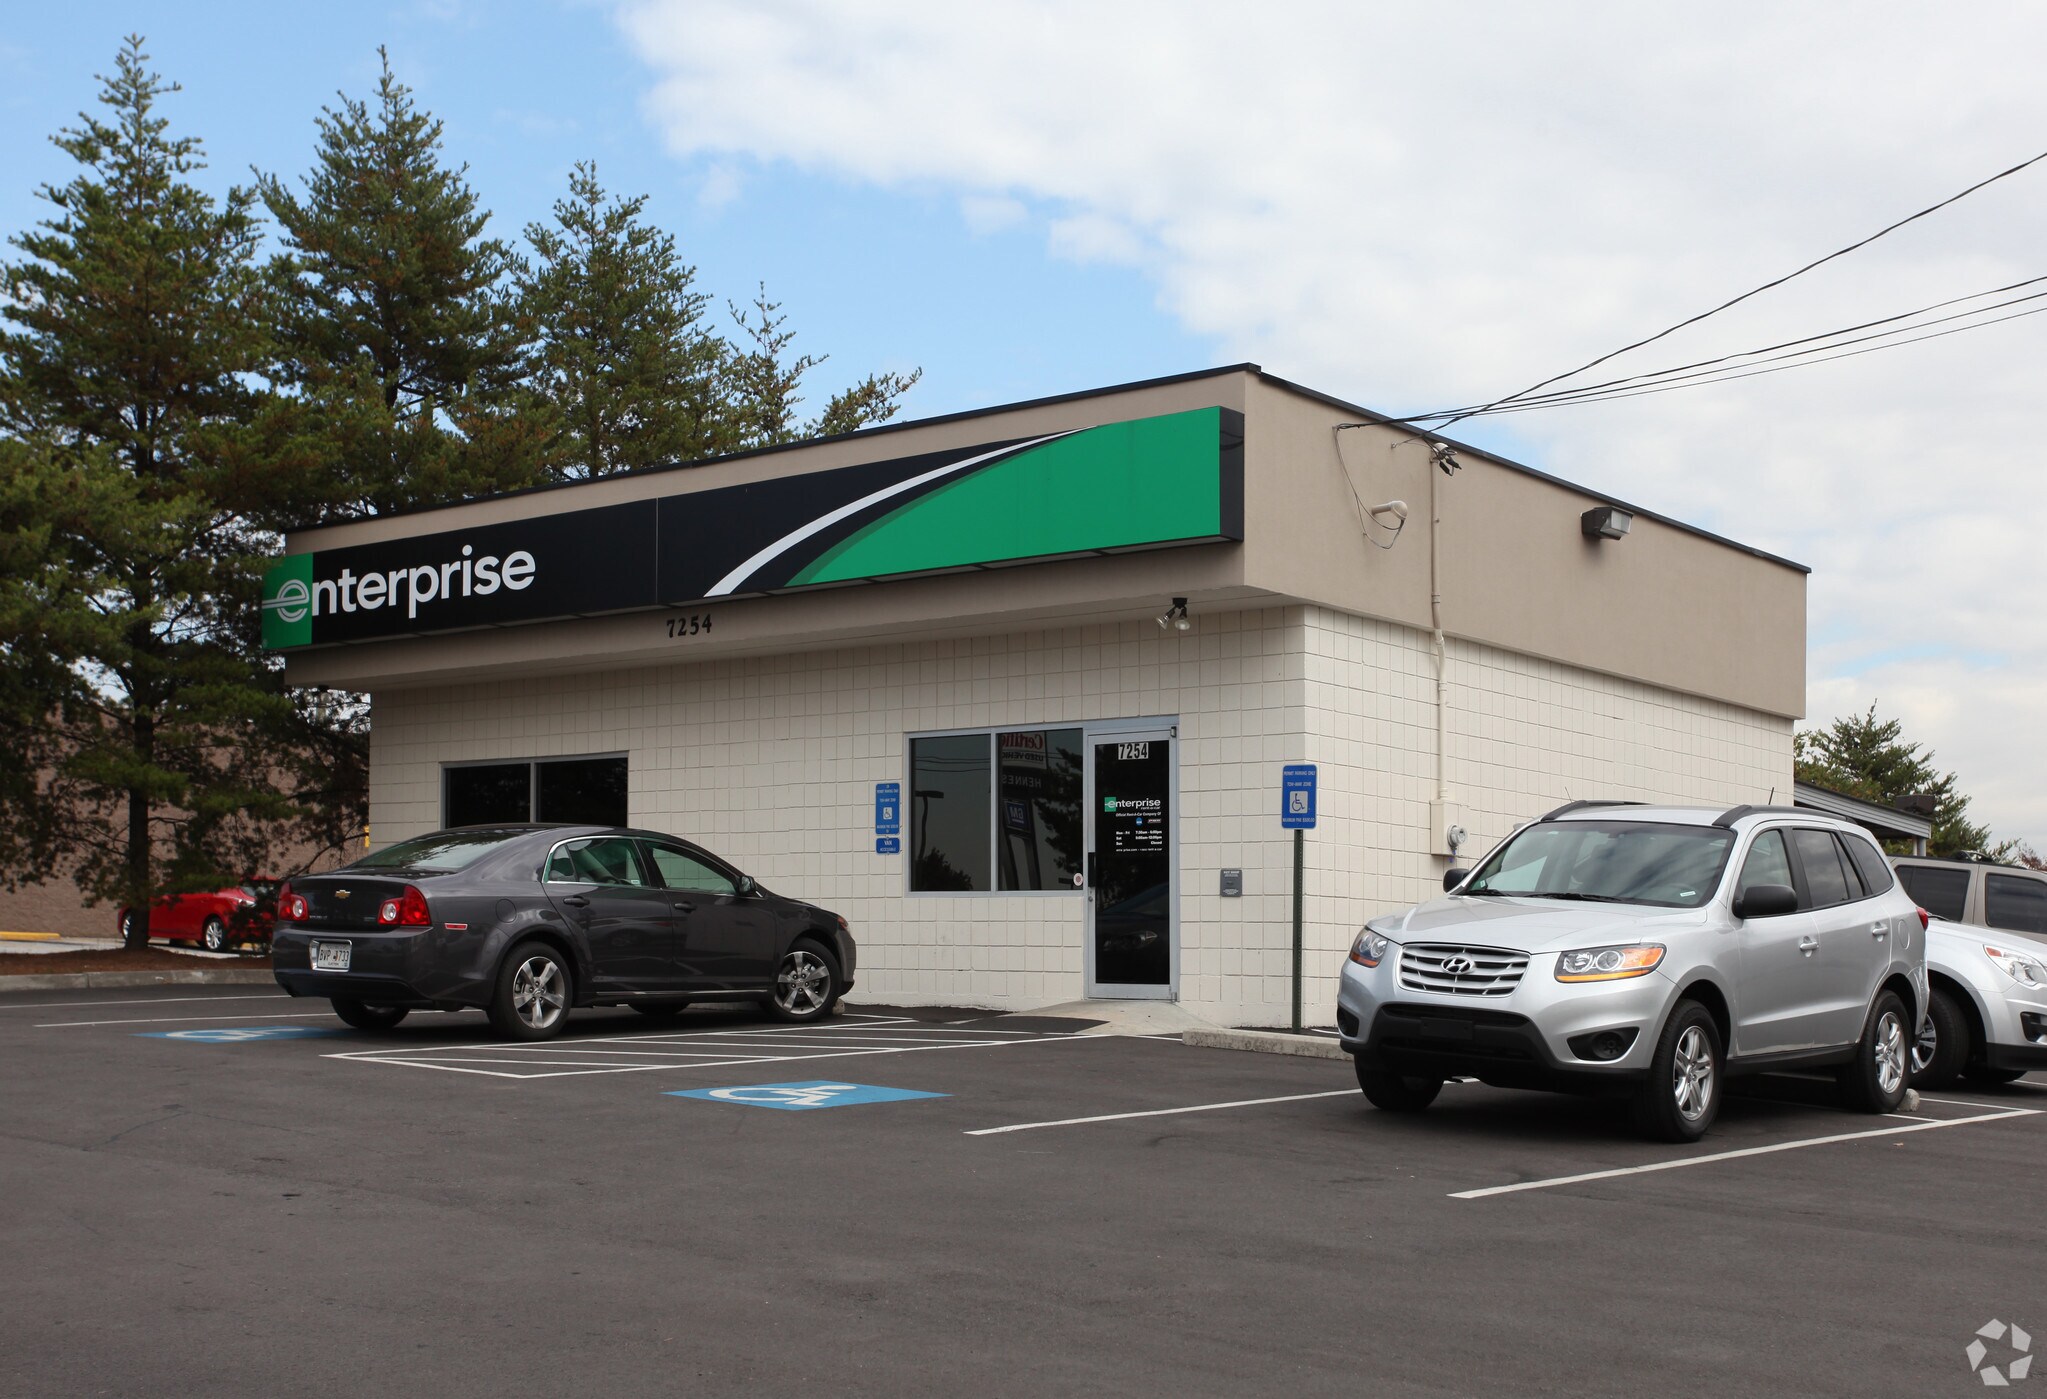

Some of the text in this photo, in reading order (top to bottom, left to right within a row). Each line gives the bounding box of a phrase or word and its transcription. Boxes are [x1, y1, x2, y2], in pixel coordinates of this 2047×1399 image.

[275, 544, 536, 623] enterprise
[666, 613, 713, 639] 7254
[1119, 742, 1148, 760] 7254
[1107, 798, 1160, 809] enterprise
